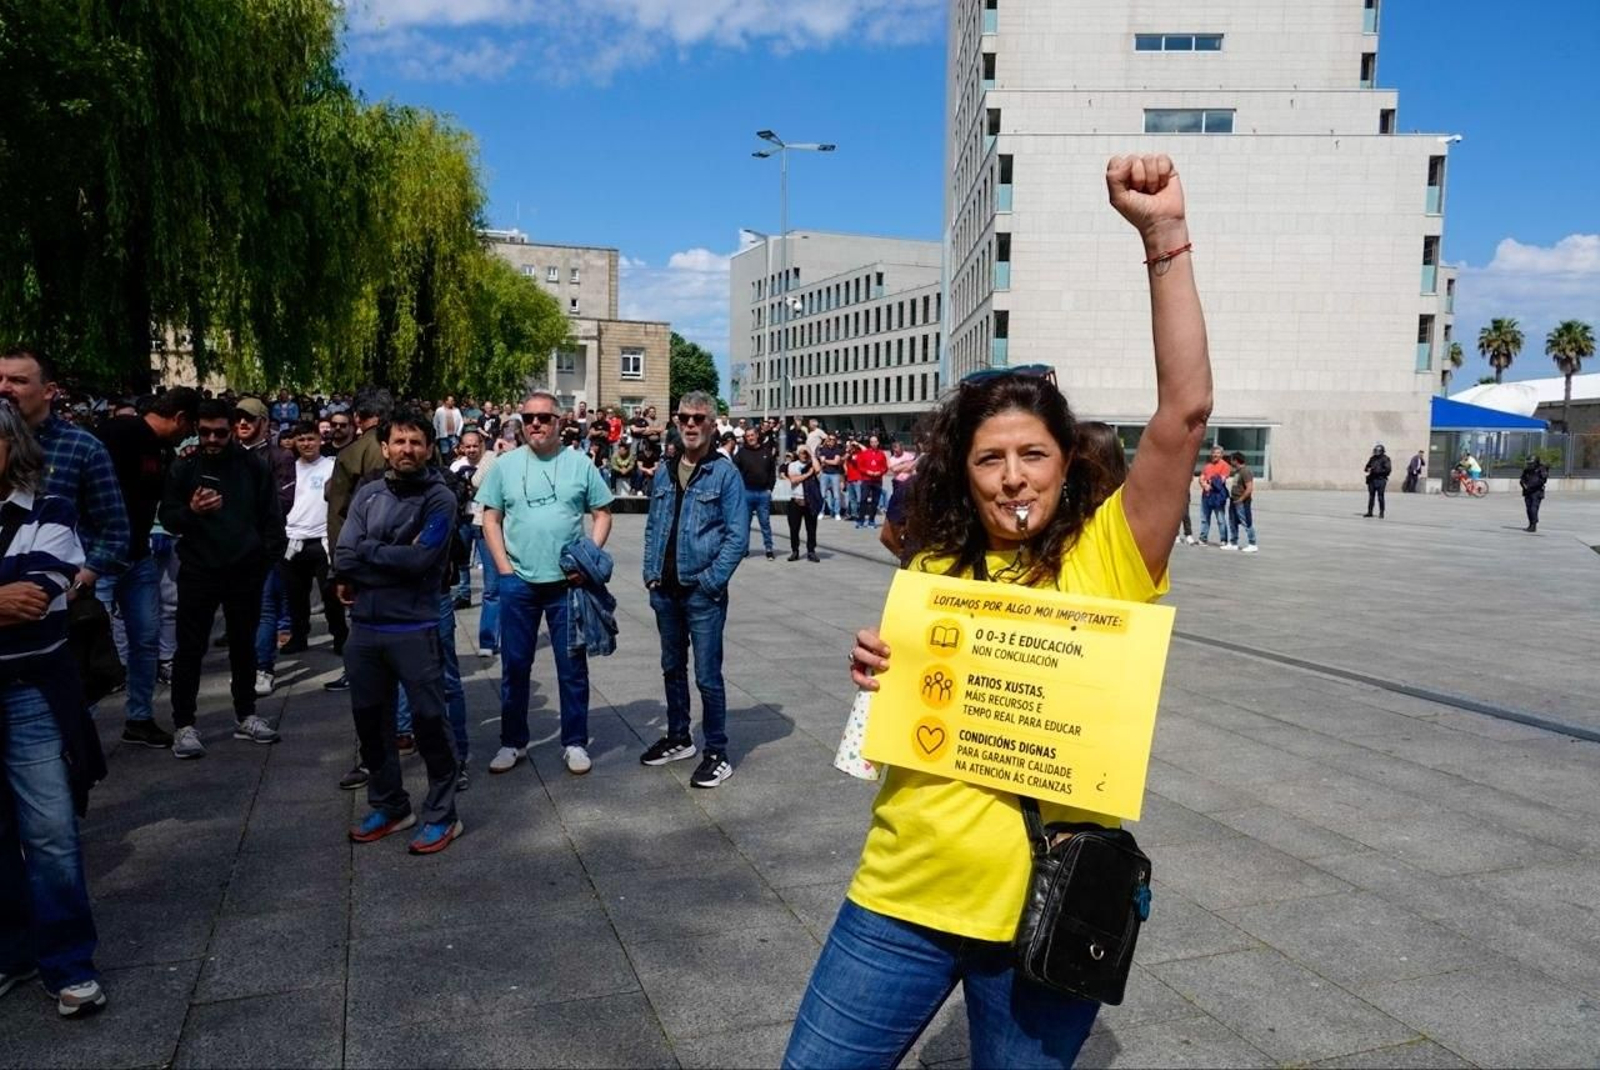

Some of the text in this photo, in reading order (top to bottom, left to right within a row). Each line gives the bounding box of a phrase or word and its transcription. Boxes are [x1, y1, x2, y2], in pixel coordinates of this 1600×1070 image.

[933, 595, 1123, 626] LOITAMOS POR ALGO MOI IMPORTANTE:
[972, 644, 1059, 668] NON CONCILIACIÓN
[976, 628, 1084, 658] O 0-3 É EDUCACIÓN,
[964, 690, 1042, 713] MÁIS RECURSOS E
[967, 674, 1045, 699] RATIOS XUSTAS,
[963, 704, 1082, 736] TEMPO REAL PARA EDUCAR
[959, 730, 1056, 759] CONDICIÓNS DIGNAS
[956, 744, 1072, 779] PARA GARANTIR CALIDADE
[954, 759, 1072, 795] NA ATENCIÓN ÁS CRIANZAS
